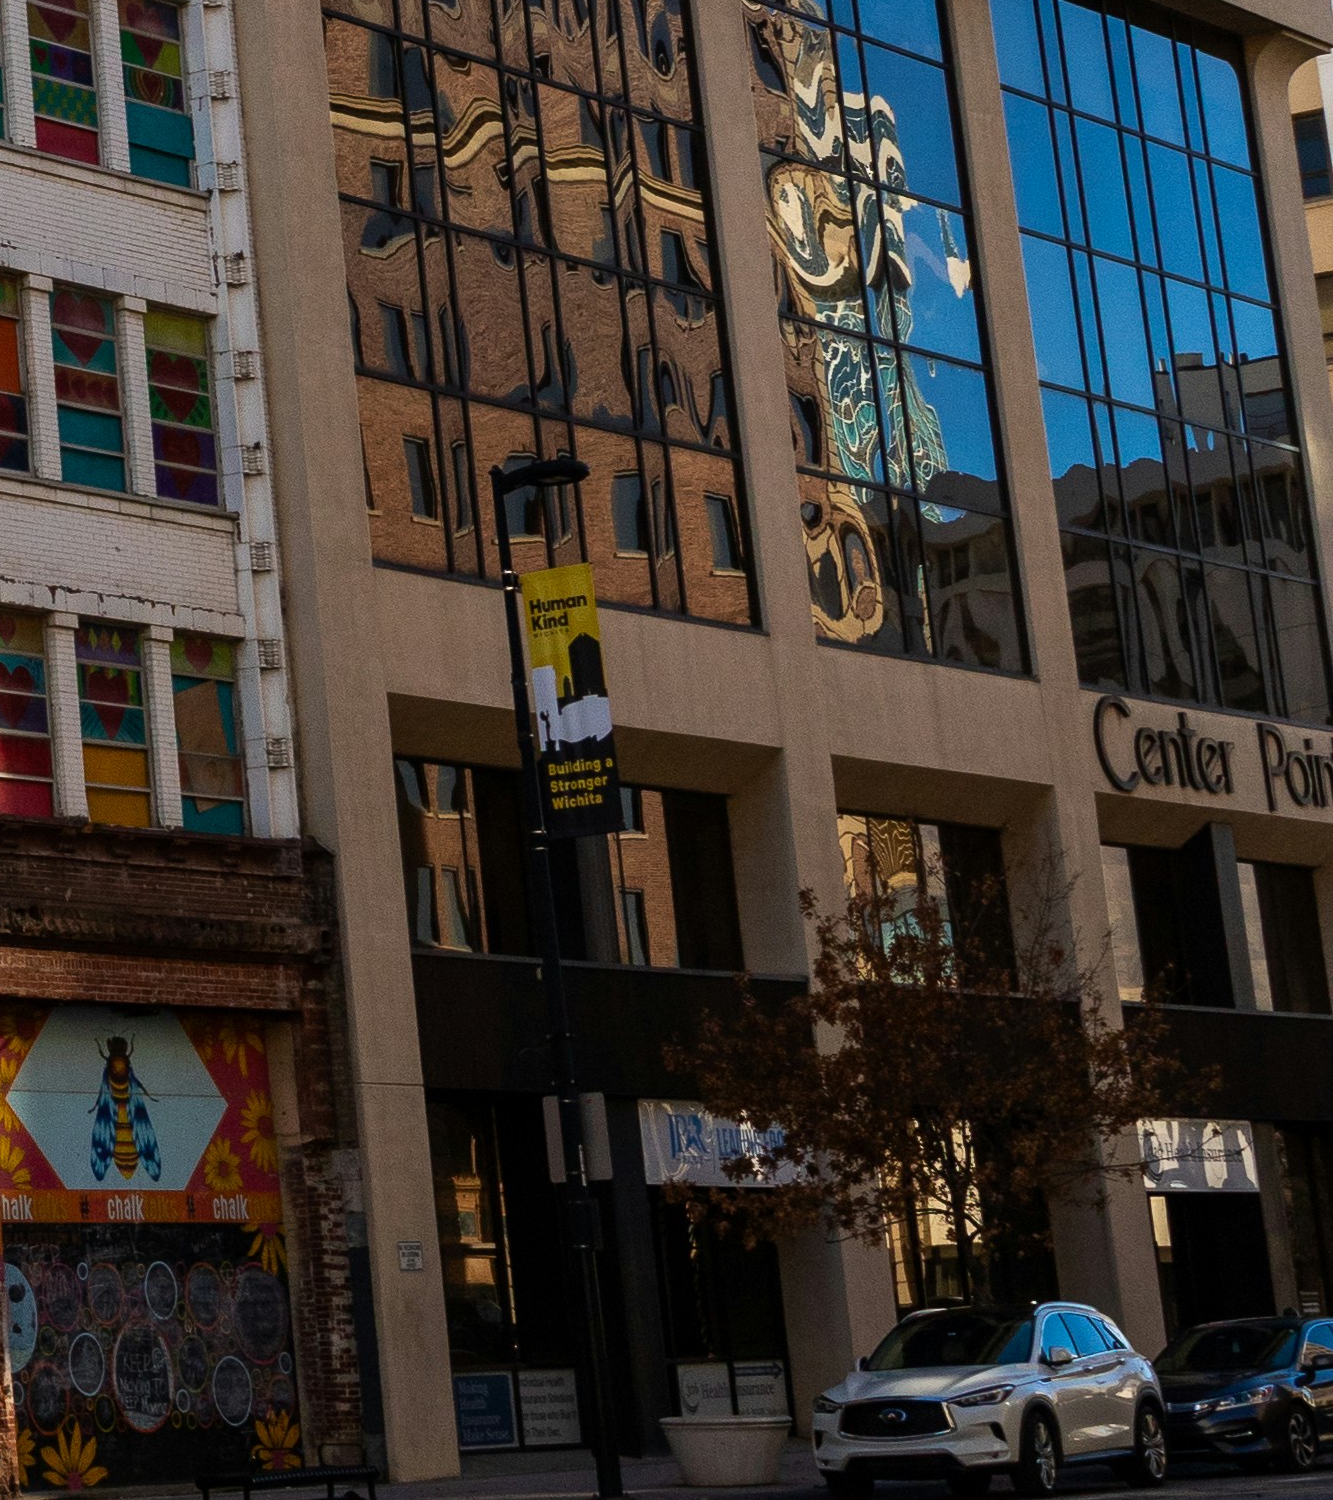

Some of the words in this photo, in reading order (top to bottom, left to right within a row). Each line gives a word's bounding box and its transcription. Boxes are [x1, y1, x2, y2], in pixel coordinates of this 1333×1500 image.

[529, 594, 588, 615] Human
[531, 612, 570, 632] Kind
[1093, 694, 1235, 794] Center
[1256, 722, 1333, 812] Poin
[548, 760, 601, 776] Building
[605, 758, 614, 768] a
[550, 775, 608, 793] Stronger
[551, 794, 604, 810] Wichita
